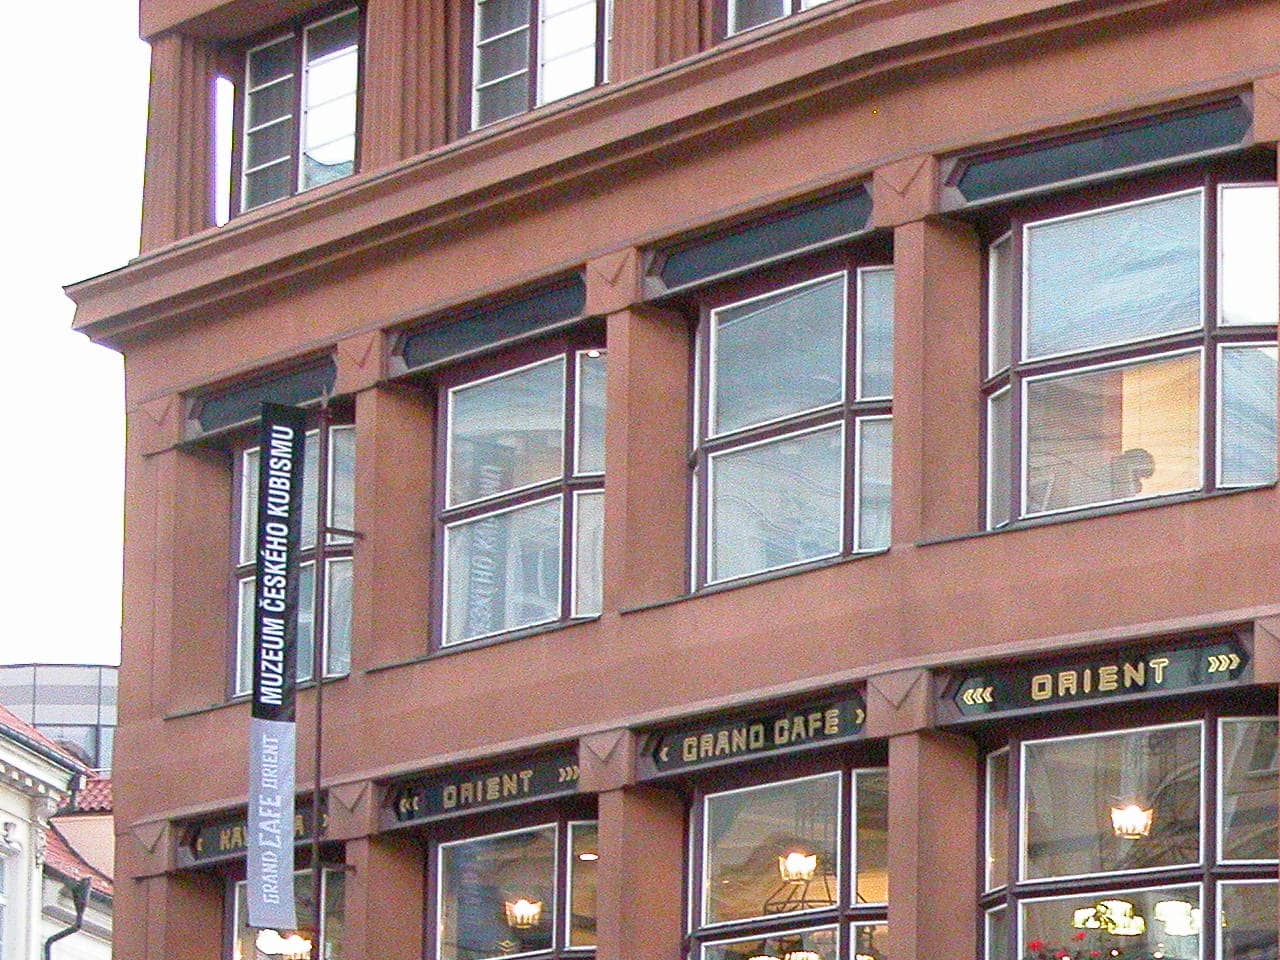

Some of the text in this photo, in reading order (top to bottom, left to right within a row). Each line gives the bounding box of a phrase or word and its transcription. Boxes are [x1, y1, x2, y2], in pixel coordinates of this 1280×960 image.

[258, 425, 295, 706] MUZEUM ČESKÉHO KUBISMU
[1031, 657, 1169, 701] ORIENT
[683, 708, 840, 762] GRAND CAFE
[443, 769, 534, 809] ORIENT
